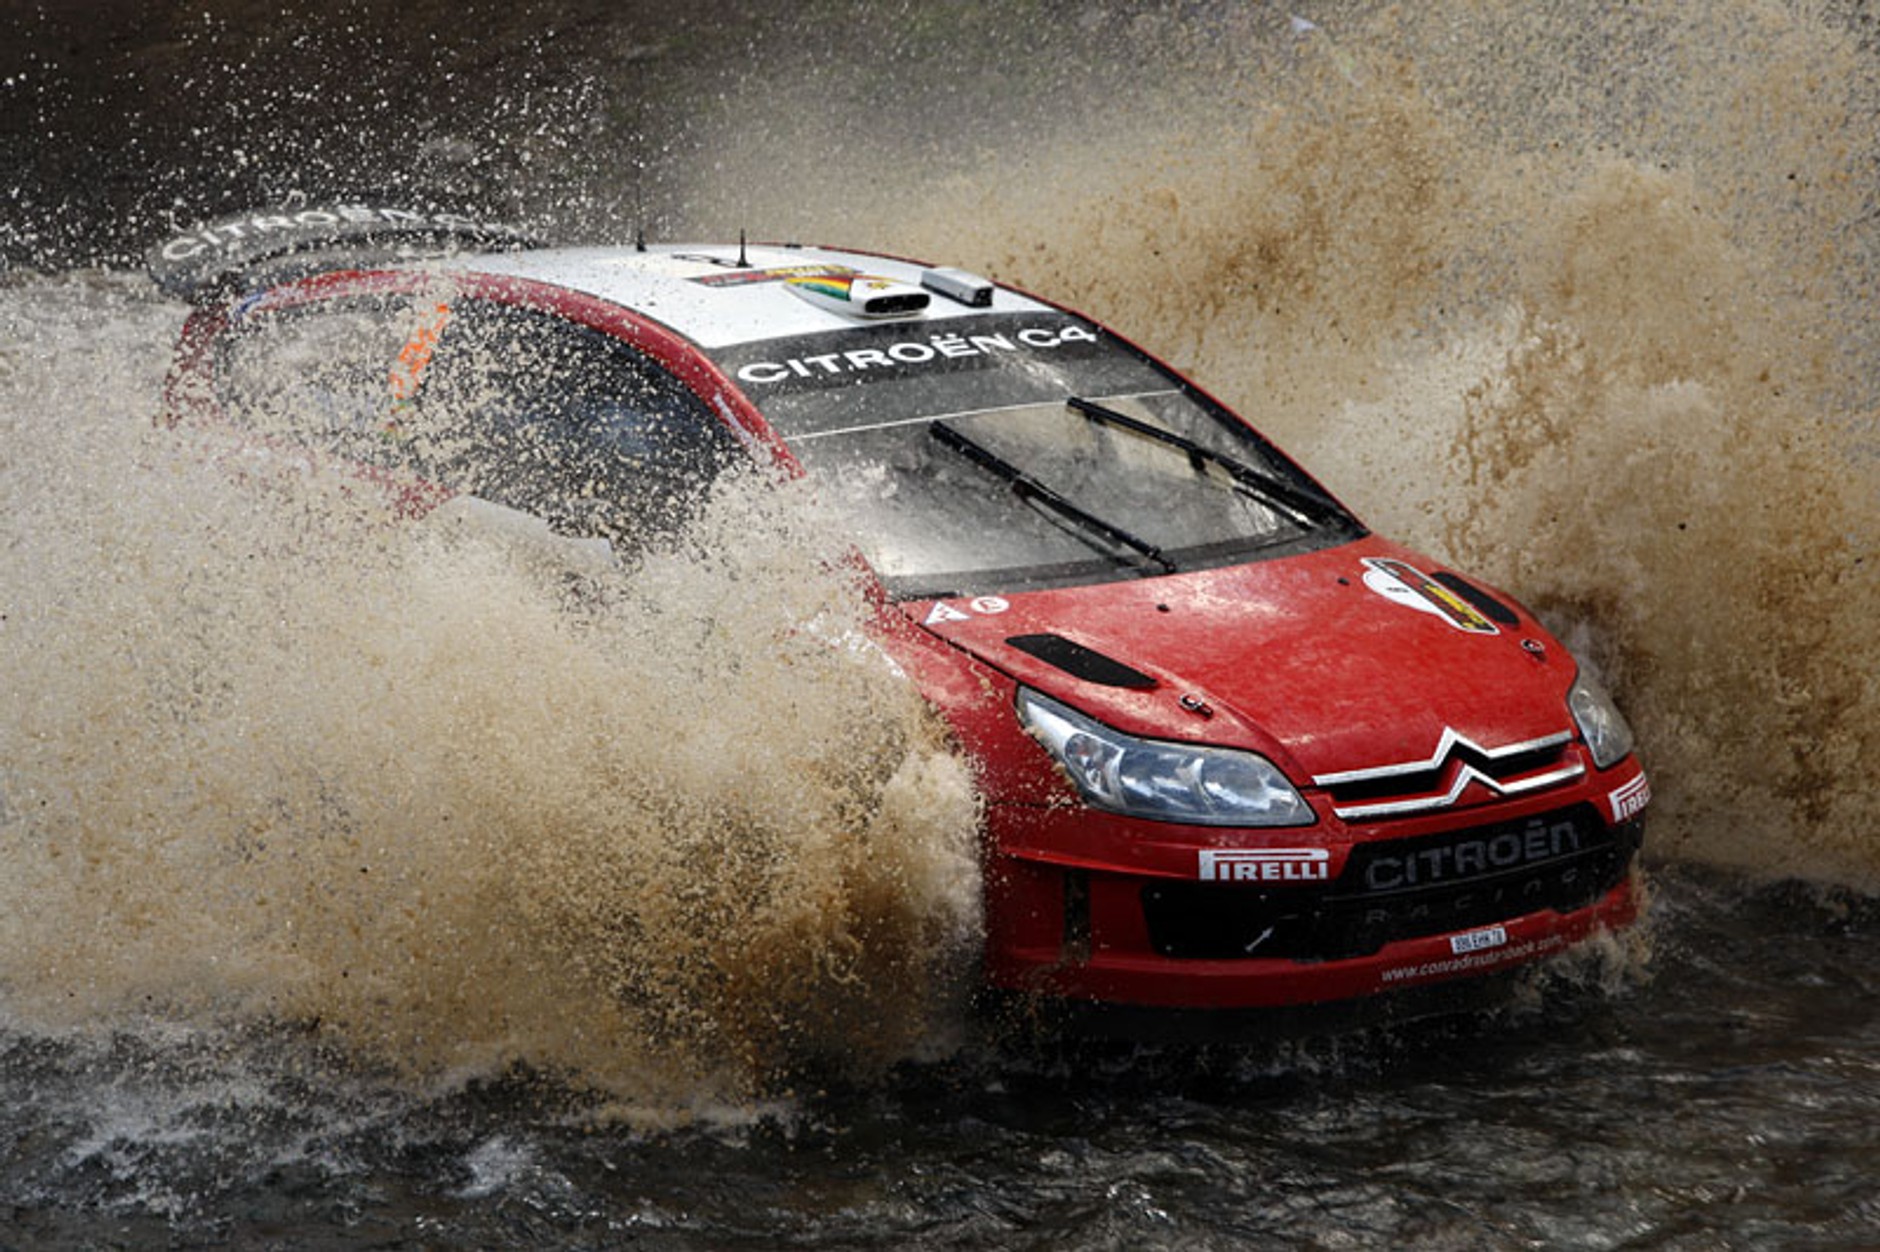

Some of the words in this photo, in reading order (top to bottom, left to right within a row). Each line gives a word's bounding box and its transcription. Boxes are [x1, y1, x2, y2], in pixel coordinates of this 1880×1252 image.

[736, 332, 1018, 385] CITROËN
[1017, 325, 1098, 349] C4
[1198, 848, 1330, 881] PIRELLI
[1364, 817, 1581, 891] CITROËN
